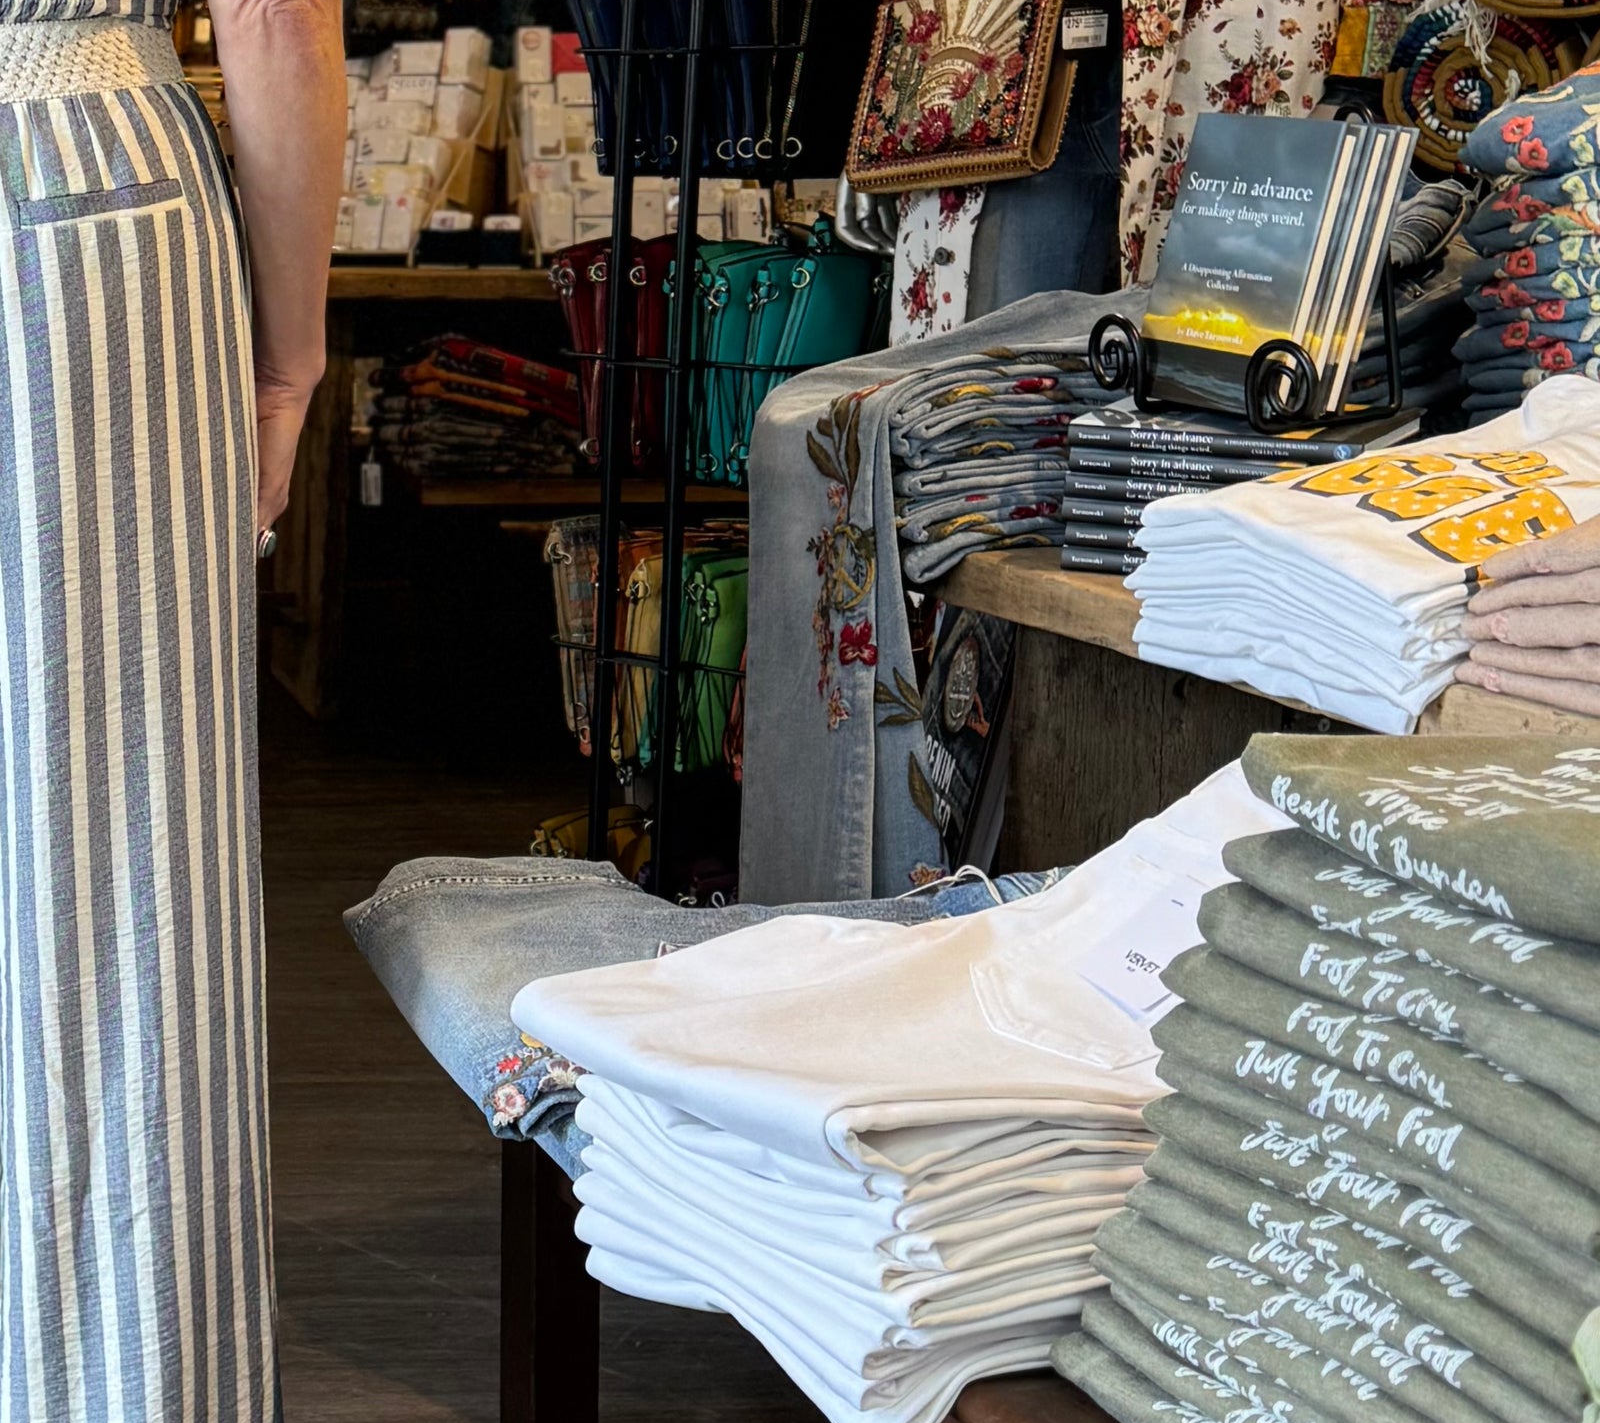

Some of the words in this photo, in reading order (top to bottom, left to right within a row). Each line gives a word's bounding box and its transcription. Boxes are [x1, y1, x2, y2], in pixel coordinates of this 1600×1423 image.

[1187, 171, 1229, 200] Sorry
[1232, 176, 1248, 195] in
[1251, 177, 1313, 202] advance
[1181, 200, 1196, 215] for
[1198, 202, 1235, 225] making
[1237, 205, 1268, 228] things
[1271, 211, 1305, 227] weird.
[1181, 263, 1188, 271] A
[1189, 264, 1232, 280] Disappointing
[1206, 279, 1240, 292] Collection
[1130, 429, 1158, 442] Sorry
[1160, 430, 1171, 442] in
[1172, 431, 1214, 444] advance
[1141, 442, 1167, 451] making
[1168, 443, 1190, 454] things
[1130, 456, 1158, 470] Sorry
[1160, 458, 1171, 469] in
[1172, 458, 1214, 472] advance
[1126, 479, 1154, 493] Sorry
[1156, 481, 1167, 492] in
[1271, 775, 1340, 840] Beast
[1389, 835, 1514, 920] Burden
[1315, 865, 1396, 897] Just
[1367, 892, 1475, 930] Your
[1469, 923, 1554, 963] Fool
[1299, 942, 1367, 998] Fool
[1362, 970, 1405, 1009] To
[1396, 988, 1460, 1035] Cry
[1286, 1001, 1357, 1057] Fool
[1353, 1030, 1390, 1071] To
[1388, 1050, 1453, 1108] Cry
[1235, 1041, 1302, 1090] Just
[1308, 1064, 1390, 1130] Your
[1397, 1106, 1464, 1171] Fool
[1240, 1120, 1312, 1167] Just
[1306, 1151, 1400, 1210] Your
[1400, 1198, 1473, 1253] Fool
[1248, 1239, 1315, 1283] Just
[1404, 1324, 1474, 1389] Fool
